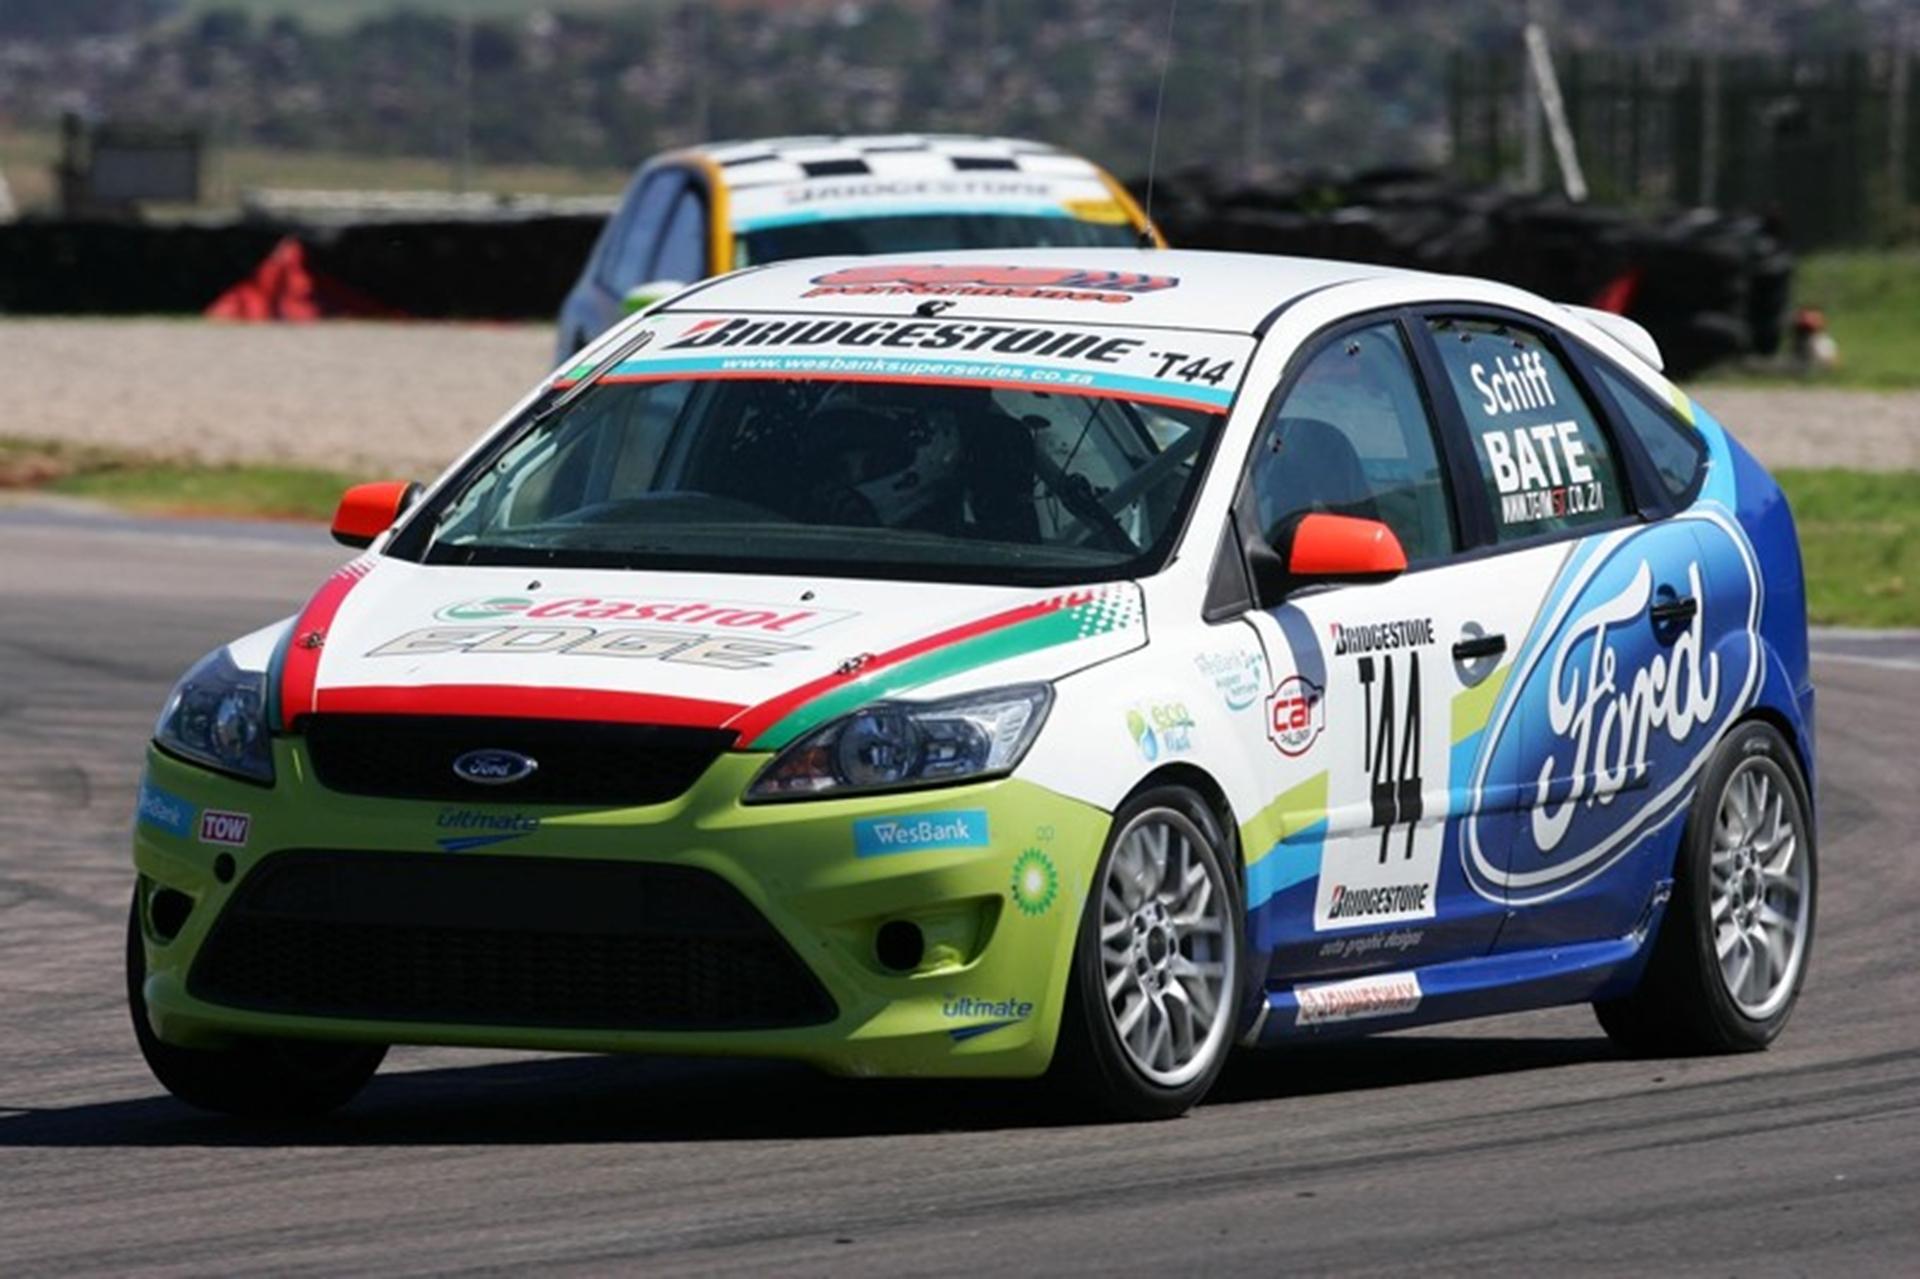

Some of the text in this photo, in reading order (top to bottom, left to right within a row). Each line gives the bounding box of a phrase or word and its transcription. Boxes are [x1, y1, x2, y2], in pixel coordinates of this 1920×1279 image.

[664, 318, 1145, 362] BRIDGESTONE
[721, 356, 1095, 385] www.wesbanksuperseries.co.za
[1470, 351, 1556, 415] Schiff
[1482, 420, 1593, 493] BATE
[526, 598, 818, 633] Castrol
[364, 626, 814, 670] EDGE
[1330, 618, 1435, 656] BRIDGESTONE
[1532, 558, 1720, 852] Ford
[470, 759, 512, 776] Ford
[1358, 652, 1422, 864] T44
[205, 815, 246, 840] TOW
[874, 819, 970, 844] WesBank
[1328, 883, 1428, 919] BRIDGESTONE
